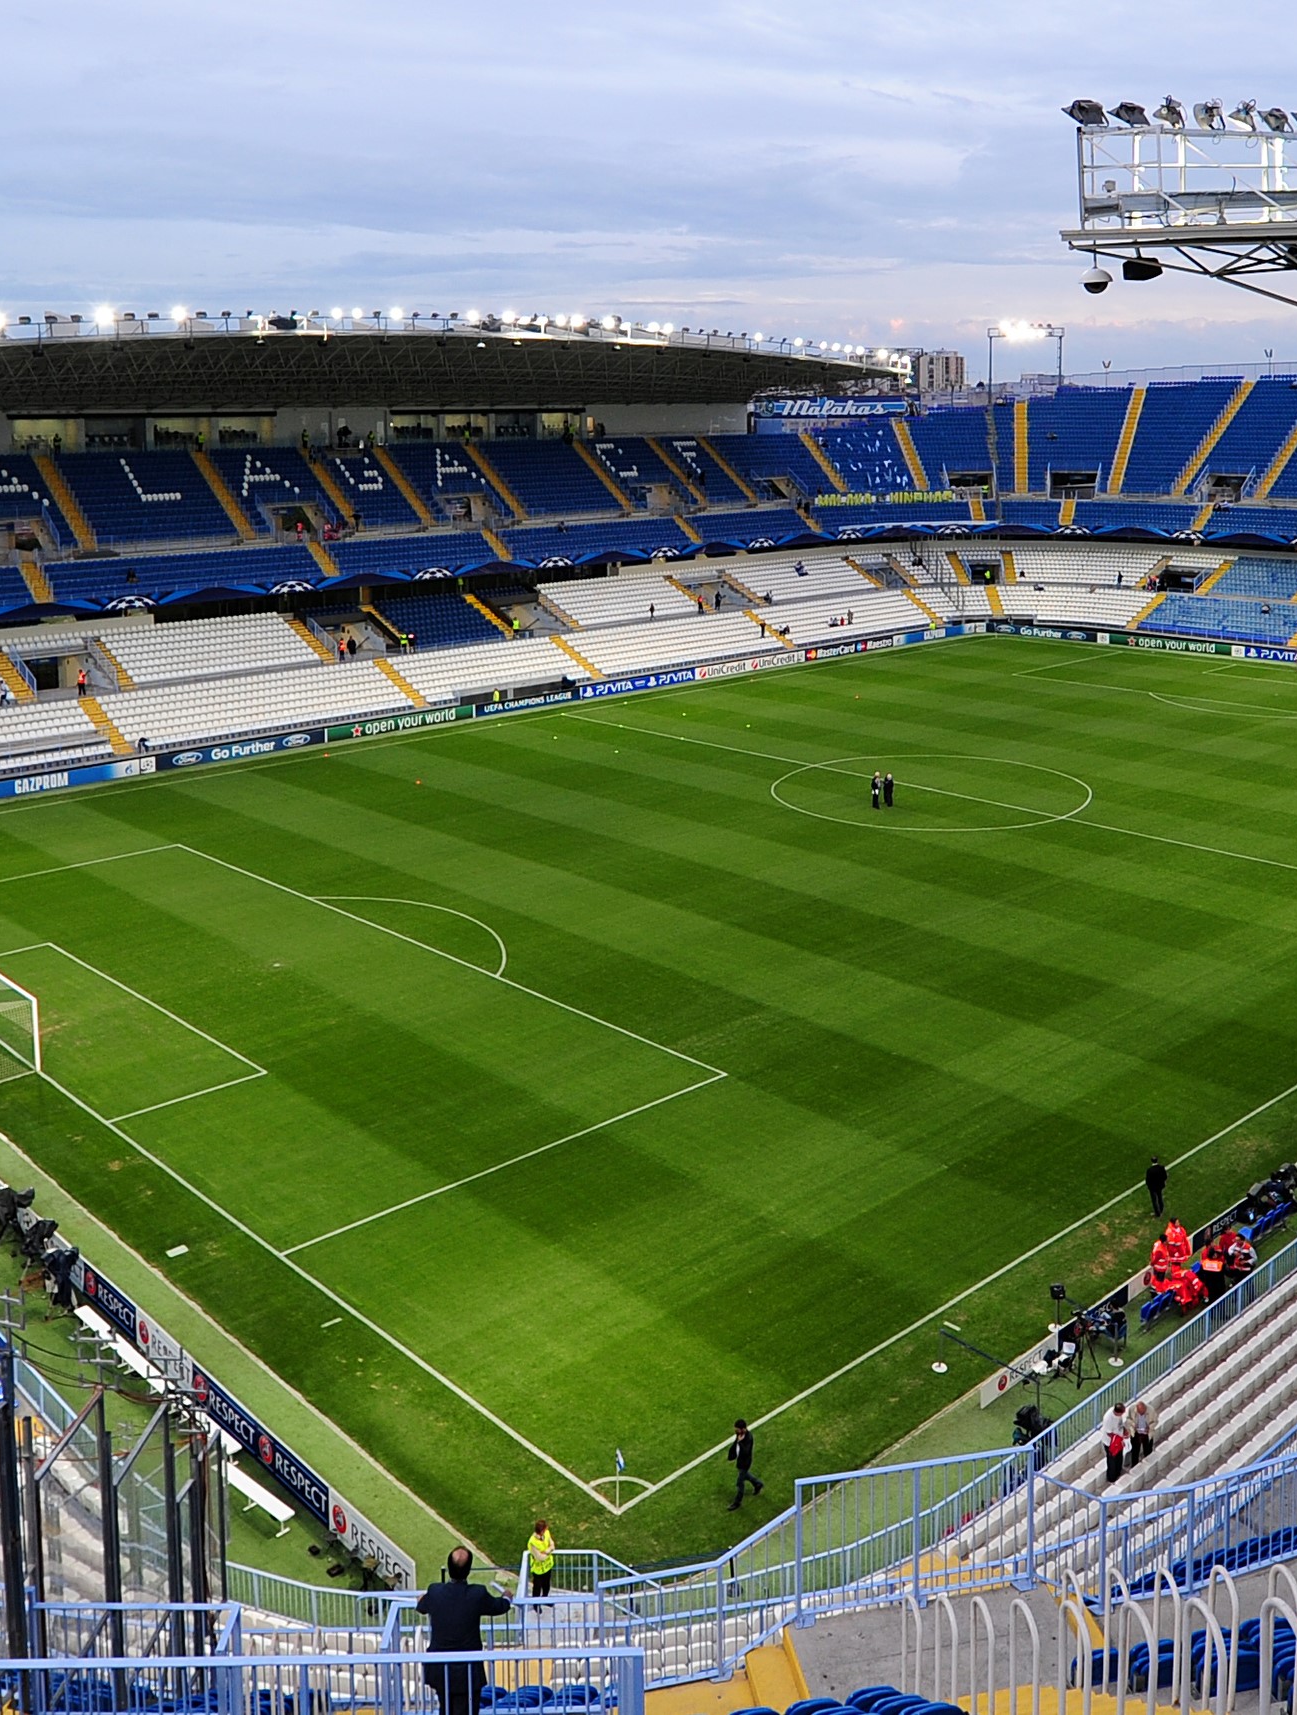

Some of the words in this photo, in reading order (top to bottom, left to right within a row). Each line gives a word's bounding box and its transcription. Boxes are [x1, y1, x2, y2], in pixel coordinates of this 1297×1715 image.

[778, 398, 889, 417] Malakas
[1019, 625, 1032, 636] Go
[1033, 627, 1063, 639] Further
[1138, 637, 1163, 651] open
[1164, 639, 1186, 652] your
[1188, 641, 1216, 654] world
[707, 661, 747, 677] UniCredit
[758, 652, 796, 668] UniCredit
[484, 702, 504, 713] UEFA
[504, 695, 545, 710] CHAMPIONS
[546, 691, 572, 702] LEAGUE
[364, 718, 395, 736] open
[397, 713, 424, 731] your
[425, 707, 457, 726] world
[210, 747, 230, 761] Go
[232, 740, 276, 757] Further
[14, 772, 69, 794] GAZPROM
[97, 1284, 135, 1329] RESPECT
[209, 1390, 256, 1444] RESPECT
[275, 1452, 328, 1513] RESPECT
[350, 1523, 412, 1589] RESPECT
